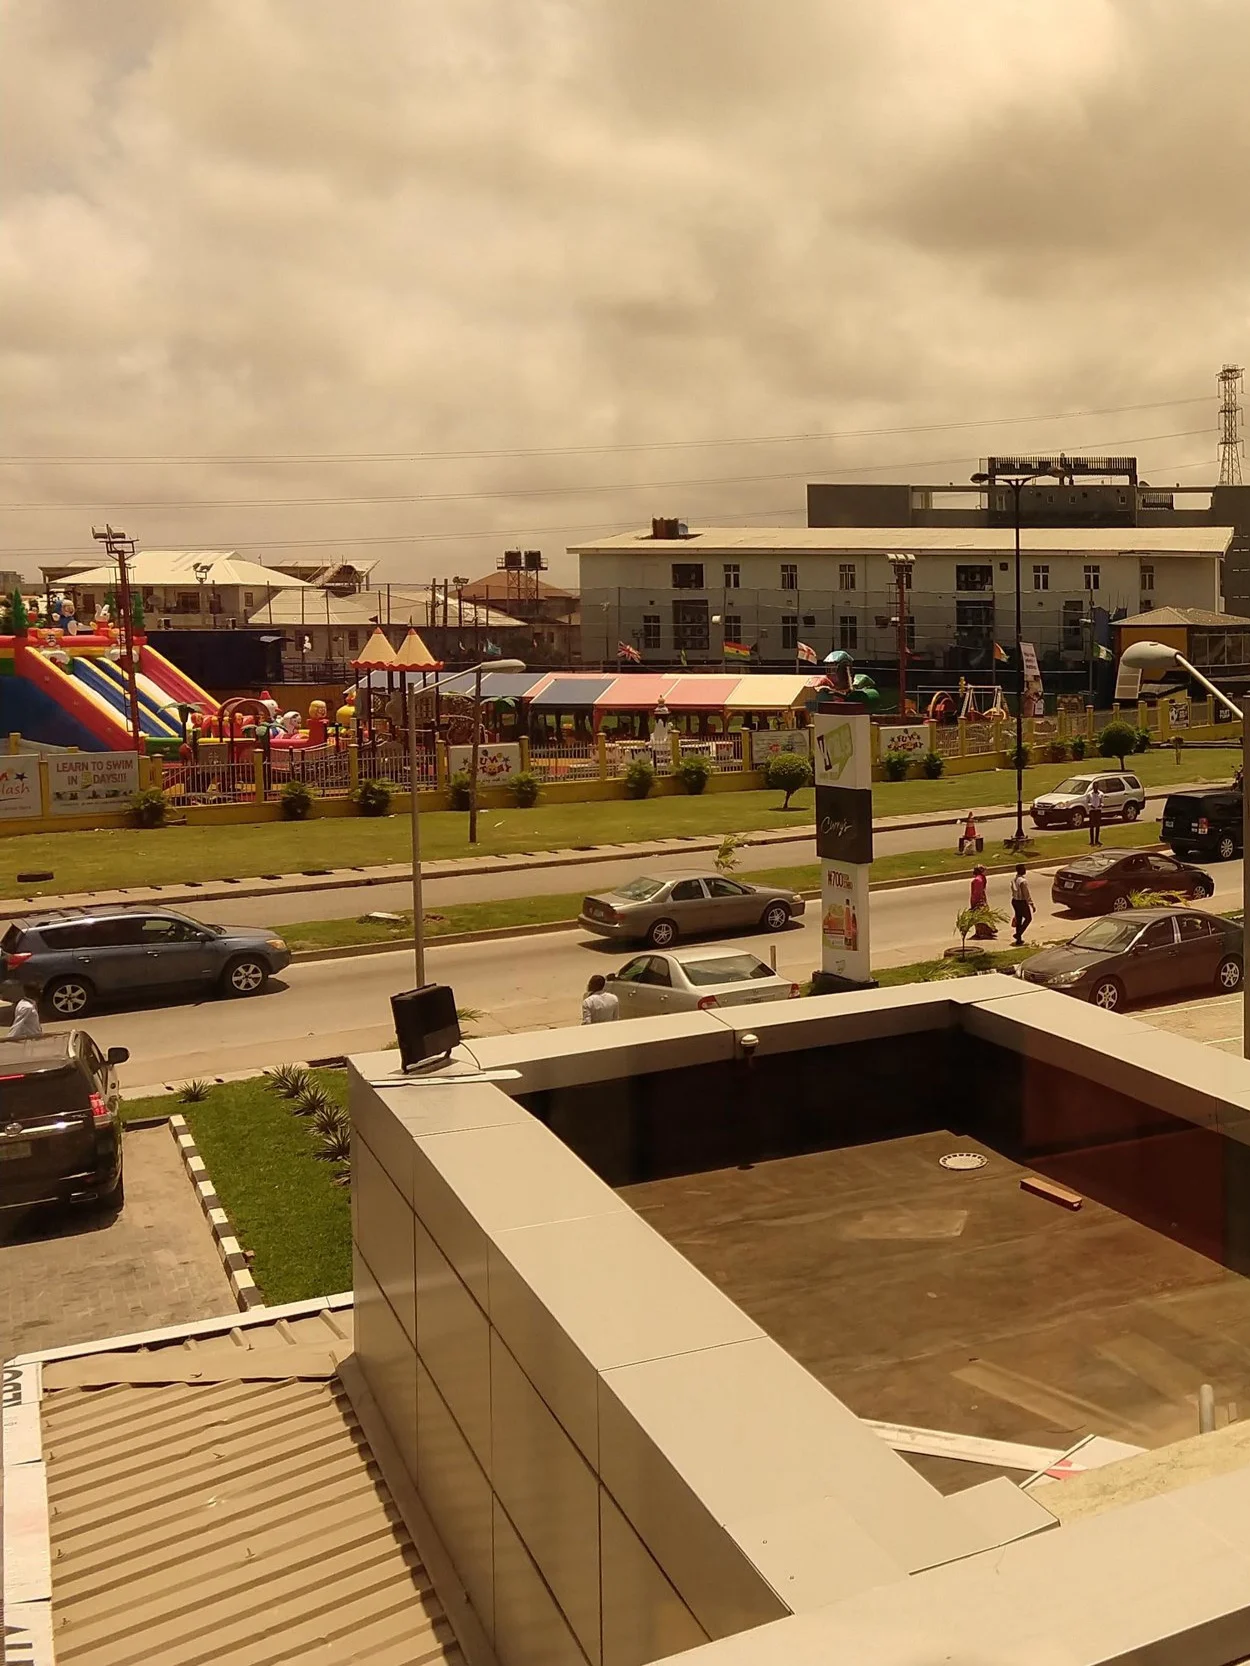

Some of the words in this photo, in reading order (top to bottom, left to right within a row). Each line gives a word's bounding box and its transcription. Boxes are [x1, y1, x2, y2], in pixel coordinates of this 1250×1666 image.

[56, 762, 89, 772] LEARN
[92, 761, 104, 771] TO
[106, 760, 133, 770] SWIM
[68, 775, 78, 786] IN
[93, 772, 127, 785] DAYS!!!
